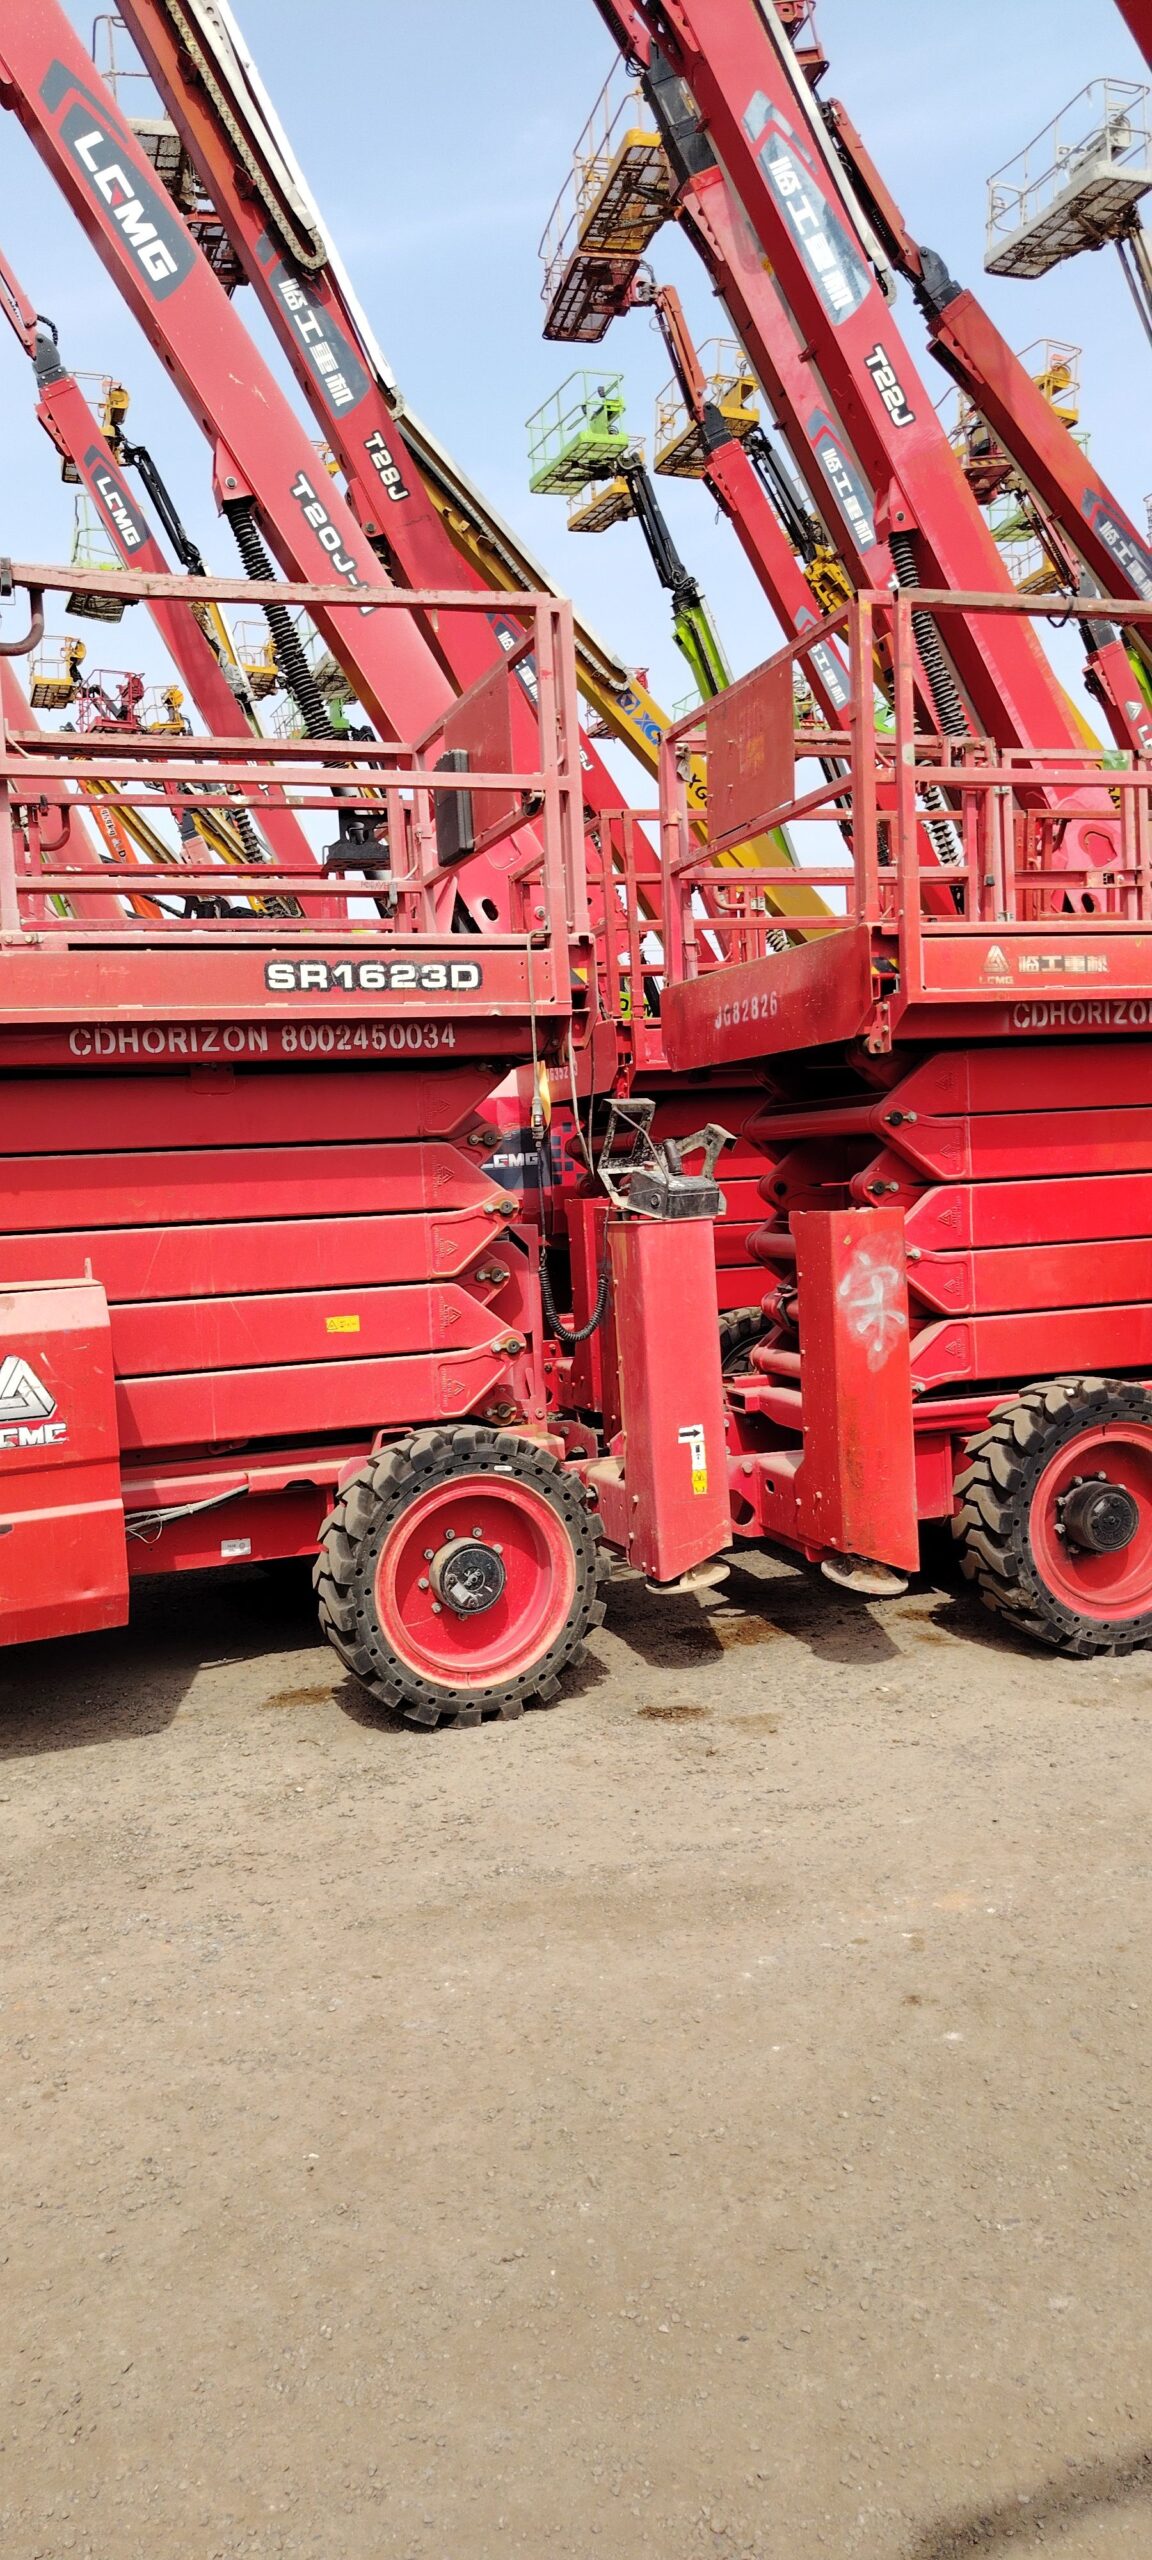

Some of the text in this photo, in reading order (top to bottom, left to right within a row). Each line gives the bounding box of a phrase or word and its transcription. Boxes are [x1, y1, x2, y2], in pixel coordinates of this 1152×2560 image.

[769, 156, 854, 311] 临工重机
[278, 277, 355, 407] 临工重机
[865, 344, 915, 427] T22J
[364, 430, 410, 502] T28J
[821, 447, 874, 545] 临工重机
[292, 472, 375, 615] T20J-
[267, 962, 480, 991] SR1623D
[714, 990, 778, 1030] JG82826
[1013, 1000, 1152, 1028] CDHORIZO
[69, 1023, 456, 1056] CDHORIZON 8002450034
